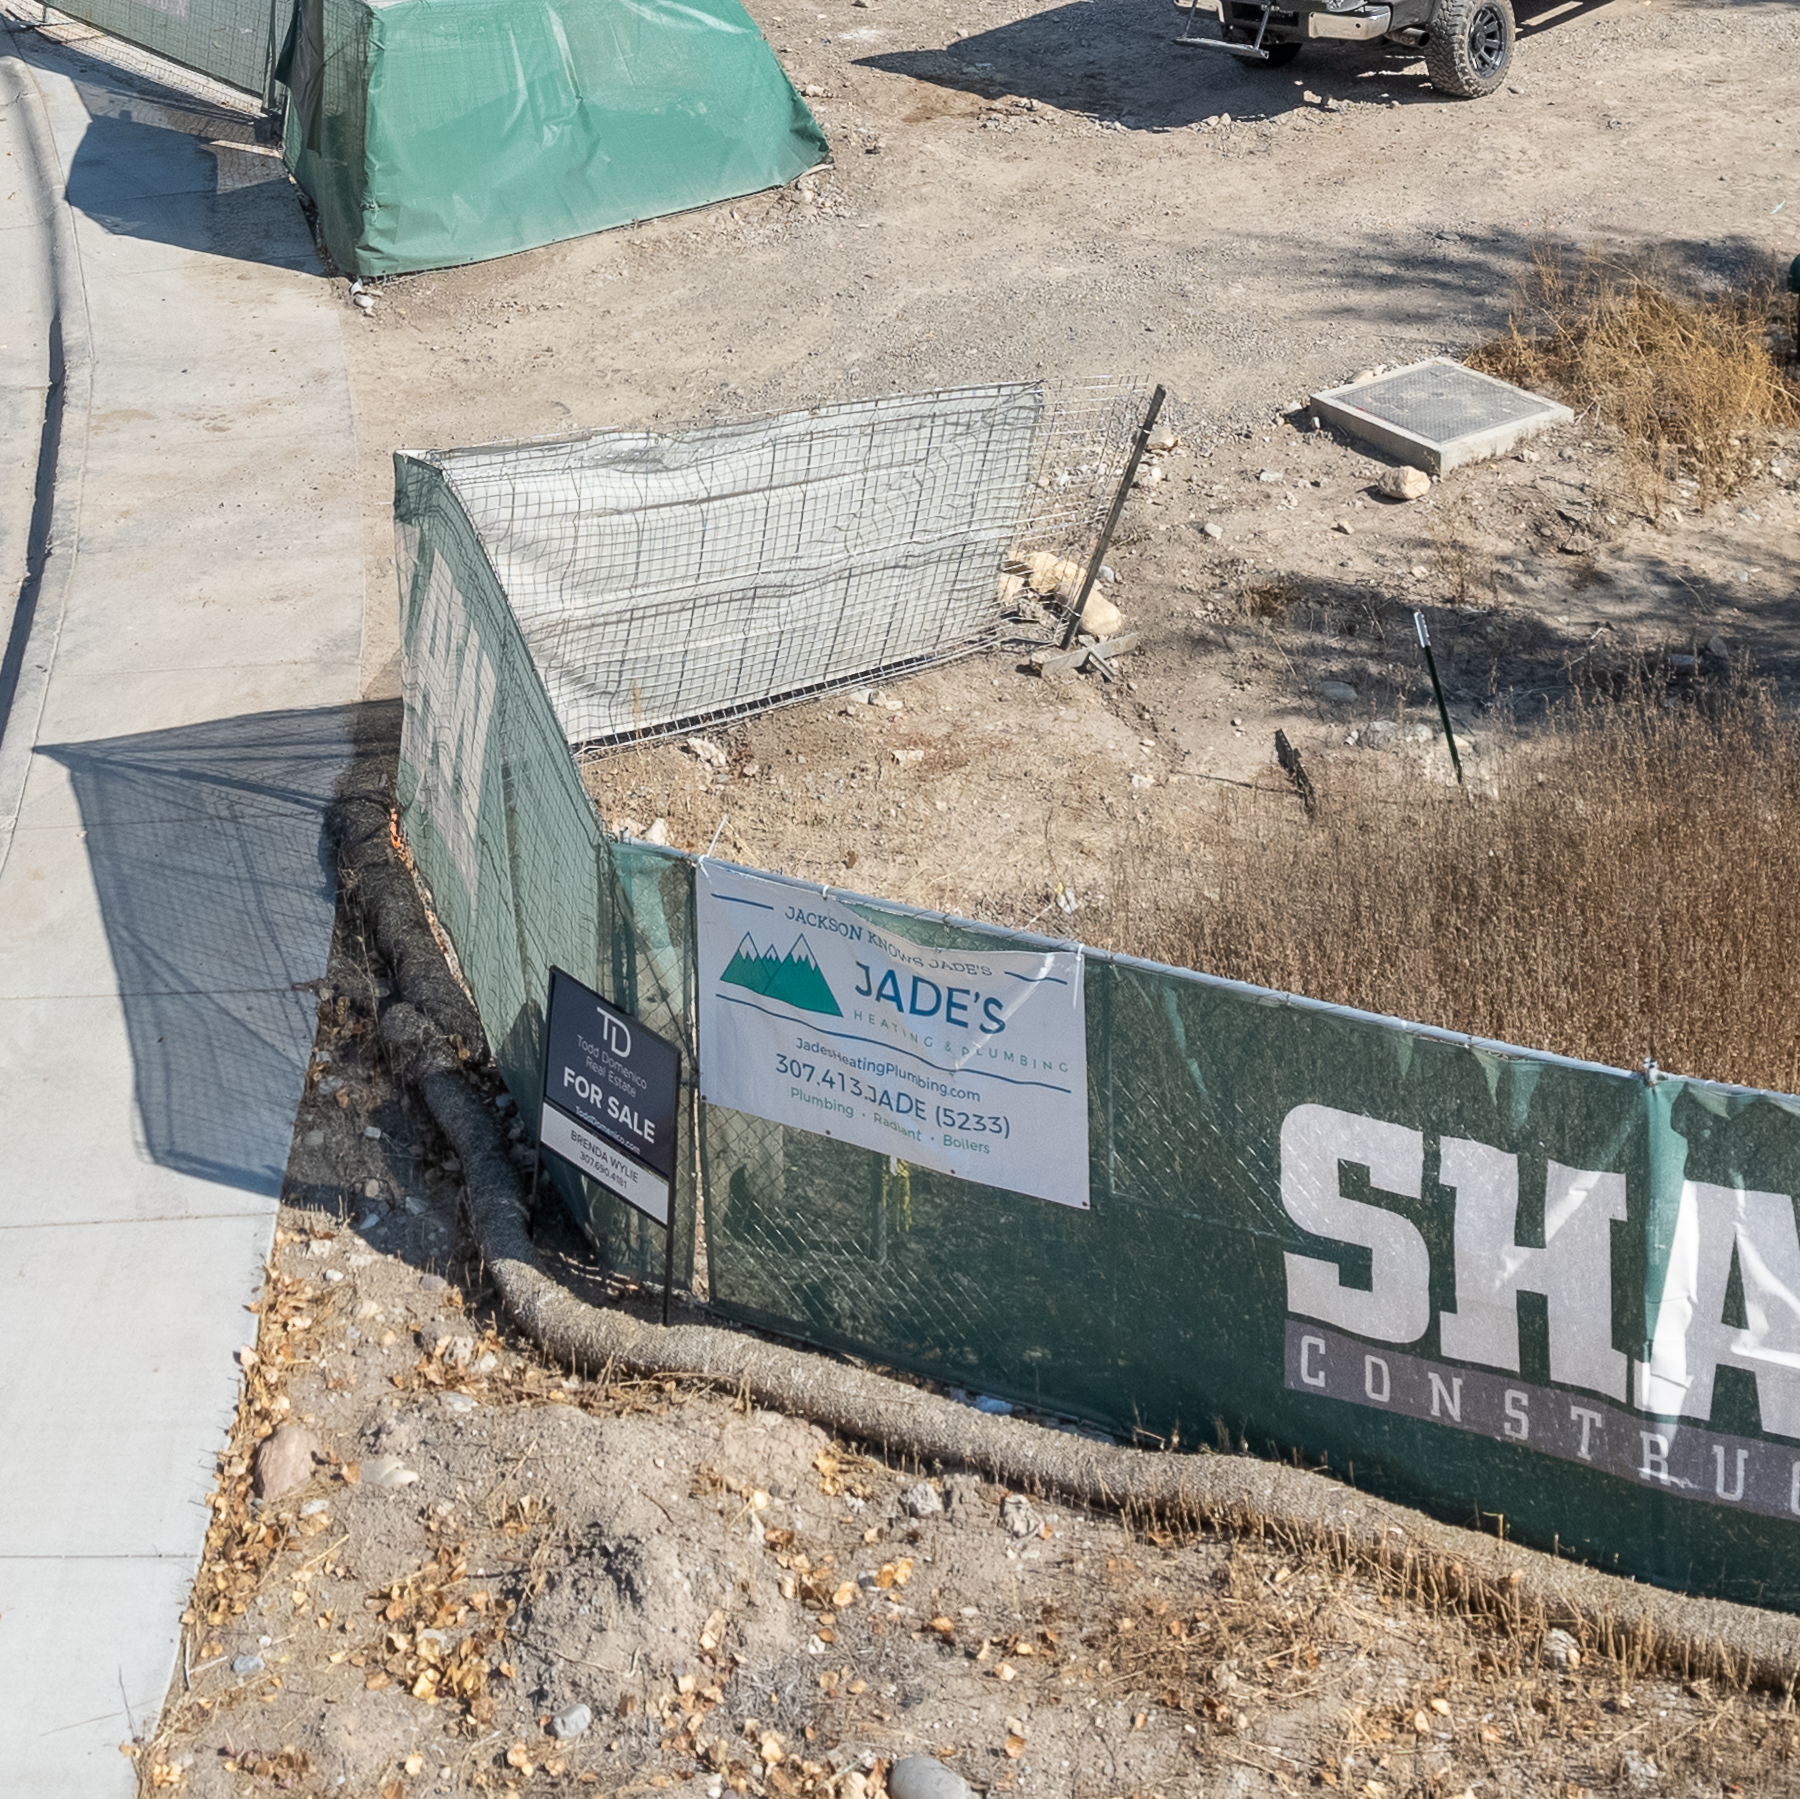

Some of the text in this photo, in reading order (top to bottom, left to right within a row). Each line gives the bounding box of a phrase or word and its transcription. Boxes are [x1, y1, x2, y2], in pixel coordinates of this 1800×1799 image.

[785, 906, 993, 977] JACKSON KNOWS JADE'S
[855, 960, 1007, 1035] JADE'S
[577, 1034, 647, 1090] Todd Domenico
[796, 1037, 982, 1102] JadesHeatingPlumbing.com
[854, 1009, 1069, 1073] HEATING & PLUMBING
[564, 1066, 656, 1144] FOR SALE
[586, 1056, 637, 1098] Real Estate
[775, 1053, 1011, 1139] 307.413.JADE (5233)
[790, 1086, 991, 1155] Plumbing Radiant Boilers
[571, 1130, 639, 1184] BRENDA WYLIE
